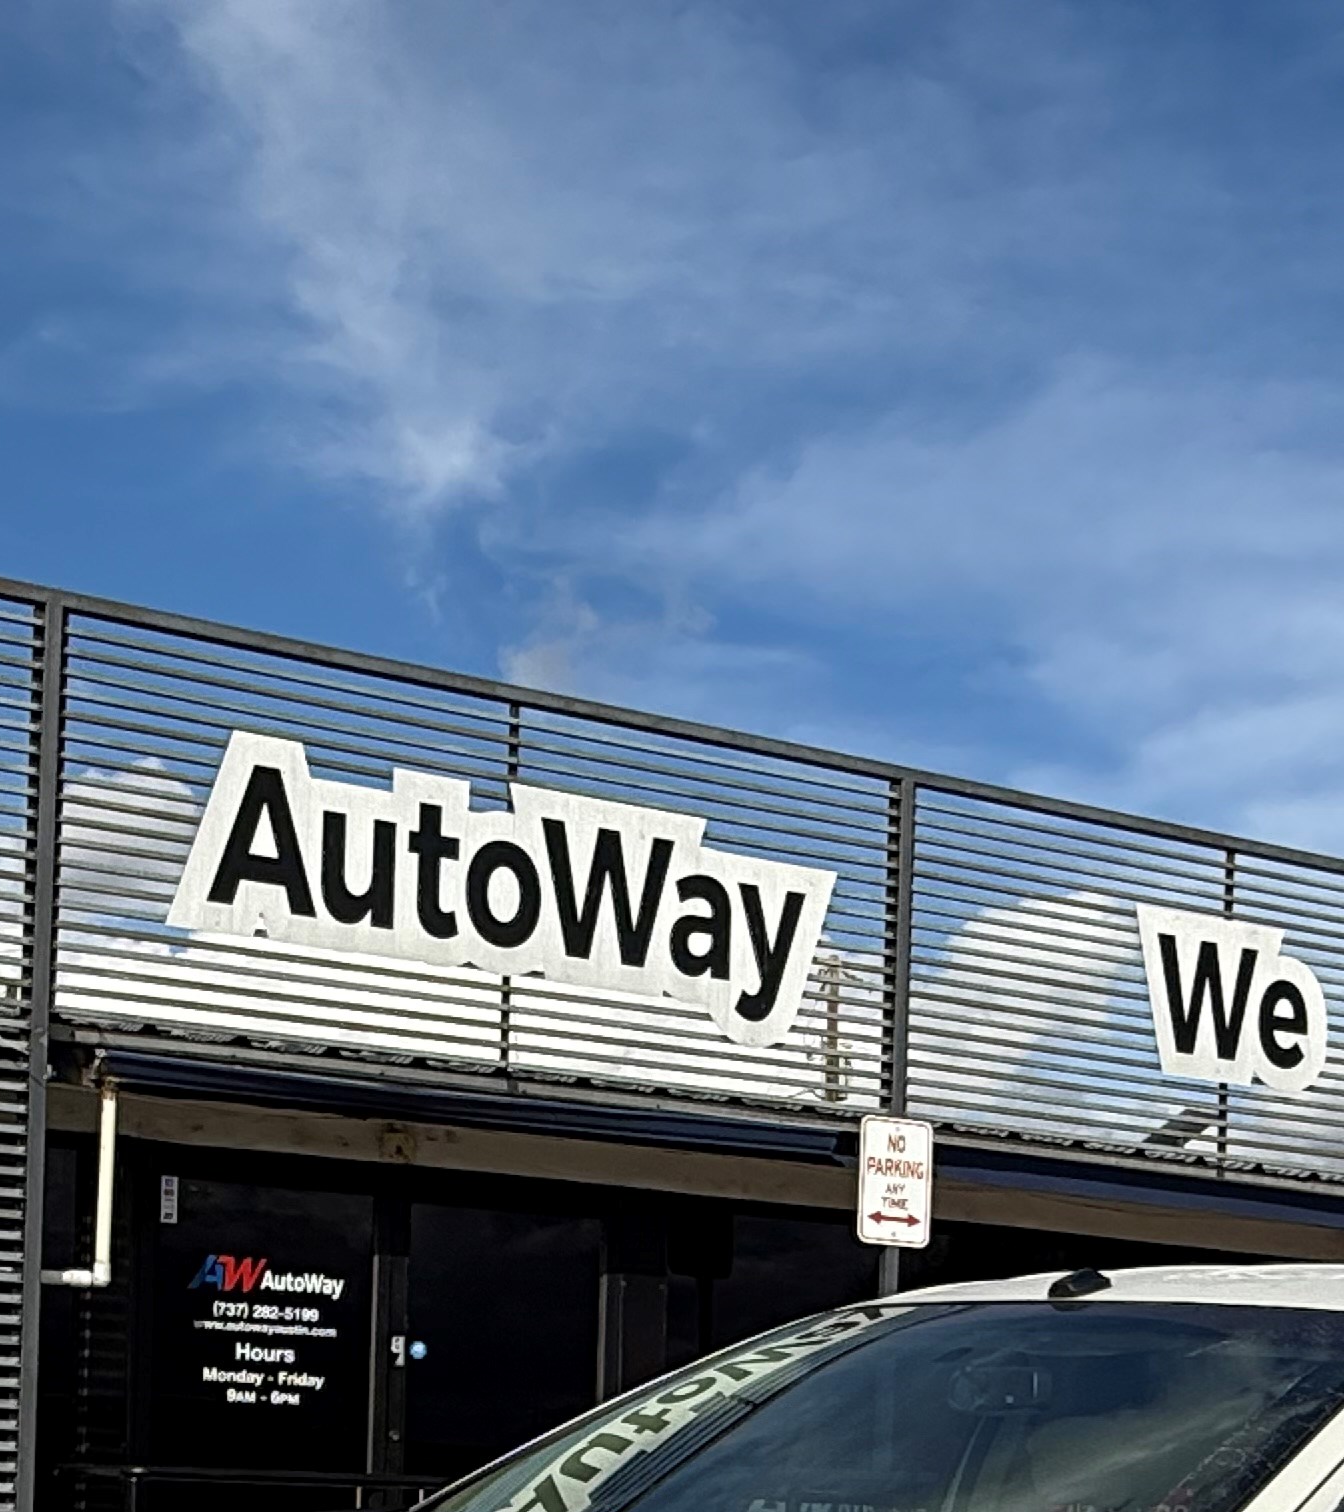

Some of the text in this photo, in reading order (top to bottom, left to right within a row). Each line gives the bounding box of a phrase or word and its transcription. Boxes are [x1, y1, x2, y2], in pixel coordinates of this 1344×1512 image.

[207, 764, 806, 1022] AutoWay
[1158, 933, 1308, 1069] We
[887, 1133, 906, 1153] NO
[867, 1156, 924, 1179] PARKING
[885, 1183, 906, 1195] ANY
[881, 1196, 908, 1211] TIME
[187, 1254, 345, 1301] AW AutoWay
[212, 1300, 320, 1322] (737) 282-5199
[235, 1342, 296, 1364] Hours
[202, 1366, 265, 1387] Monday
[277, 1370, 326, 1391] Friday
